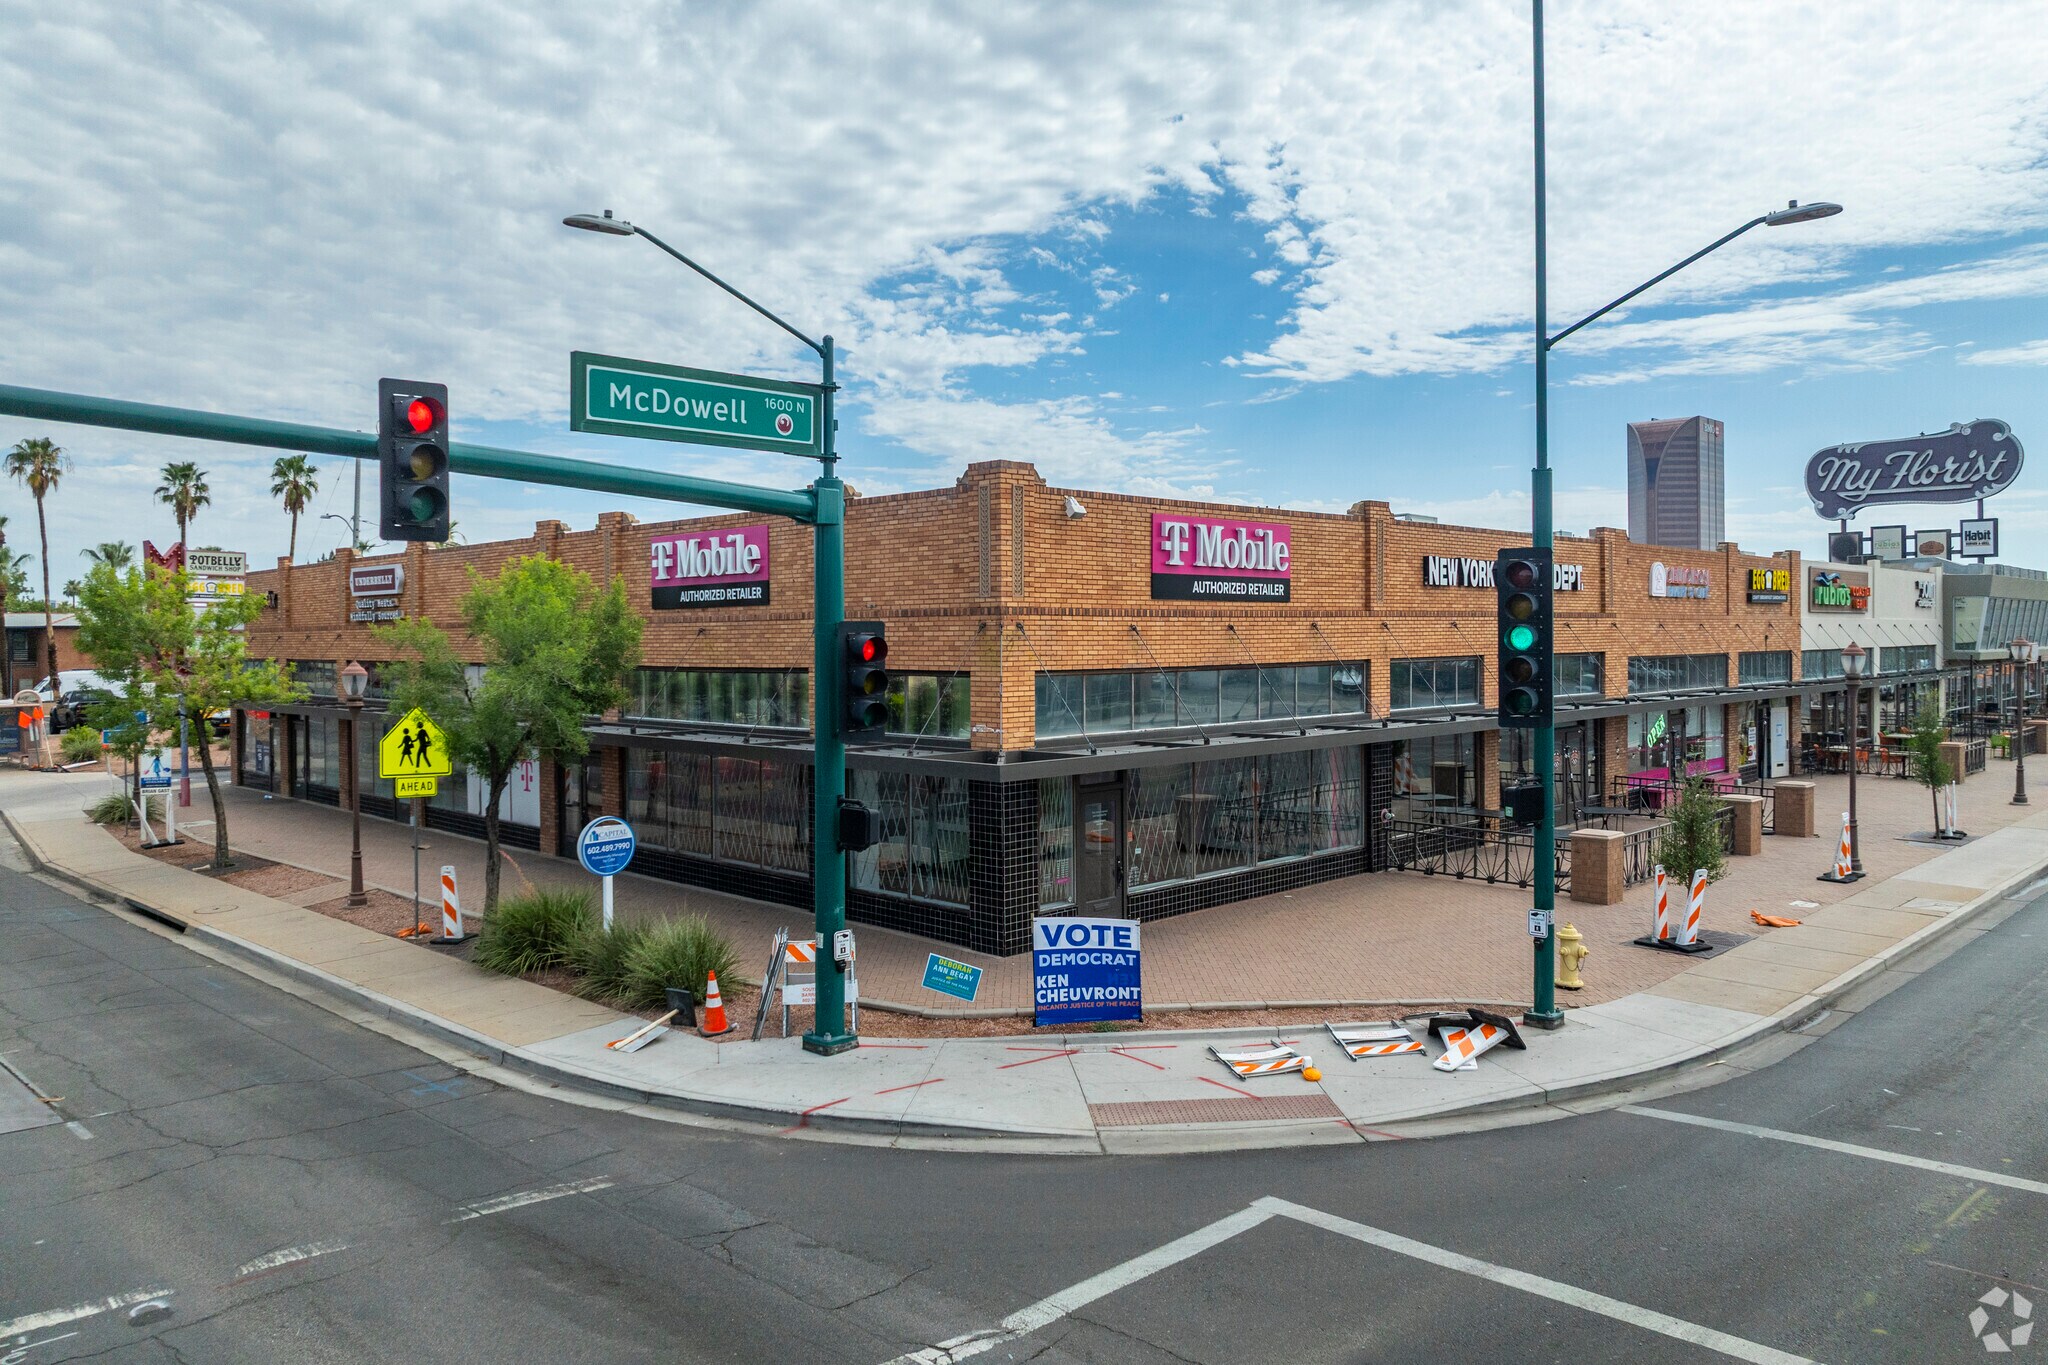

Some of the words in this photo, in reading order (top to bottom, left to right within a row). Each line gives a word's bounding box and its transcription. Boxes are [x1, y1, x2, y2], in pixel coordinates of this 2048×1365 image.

[609, 382, 748, 425] McDowell
[764, 397, 793, 412] 1600
[796, 402, 805, 413] N
[1817, 456, 1882, 502] My
[1885, 449, 2007, 489] Florist
[1964, 530, 1991, 541] Habit
[675, 533, 761, 578] Mobile
[1193, 523, 1289, 572] Mobile
[189, 554, 242, 567] POTBELLY
[1428, 555, 1459, 586] NEW
[1460, 557, 1495, 587] YORK
[1753, 568, 1766, 590] EGG
[1772, 569, 1790, 591] BRED
[680, 589, 726, 603] AUTHORIZED
[726, 587, 762, 600] RETAILER
[1192, 581, 1247, 595] AUTHORIZED
[1248, 583, 1285, 596] RETAILER
[1647, 714, 1666, 748] OPEN
[400, 781, 433, 792] AHEAD
[598, 828, 628, 838] CAPITAL
[586, 841, 631, 855] 602.489.7990
[1040, 924, 1132, 948] VOTE
[938, 958, 972, 974] DEBORAH
[1038, 952, 1137, 967] DEMOCRAT
[932, 964, 949, 974] ANN
[949, 969, 974, 982] BEGAY
[1036, 974, 1069, 989] KEN
[1036, 986, 1141, 1004] CHEUVRONT
[1037, 1003, 1069, 1011] ENCANTO
[1069, 1001, 1095, 1009] JUSTICE
